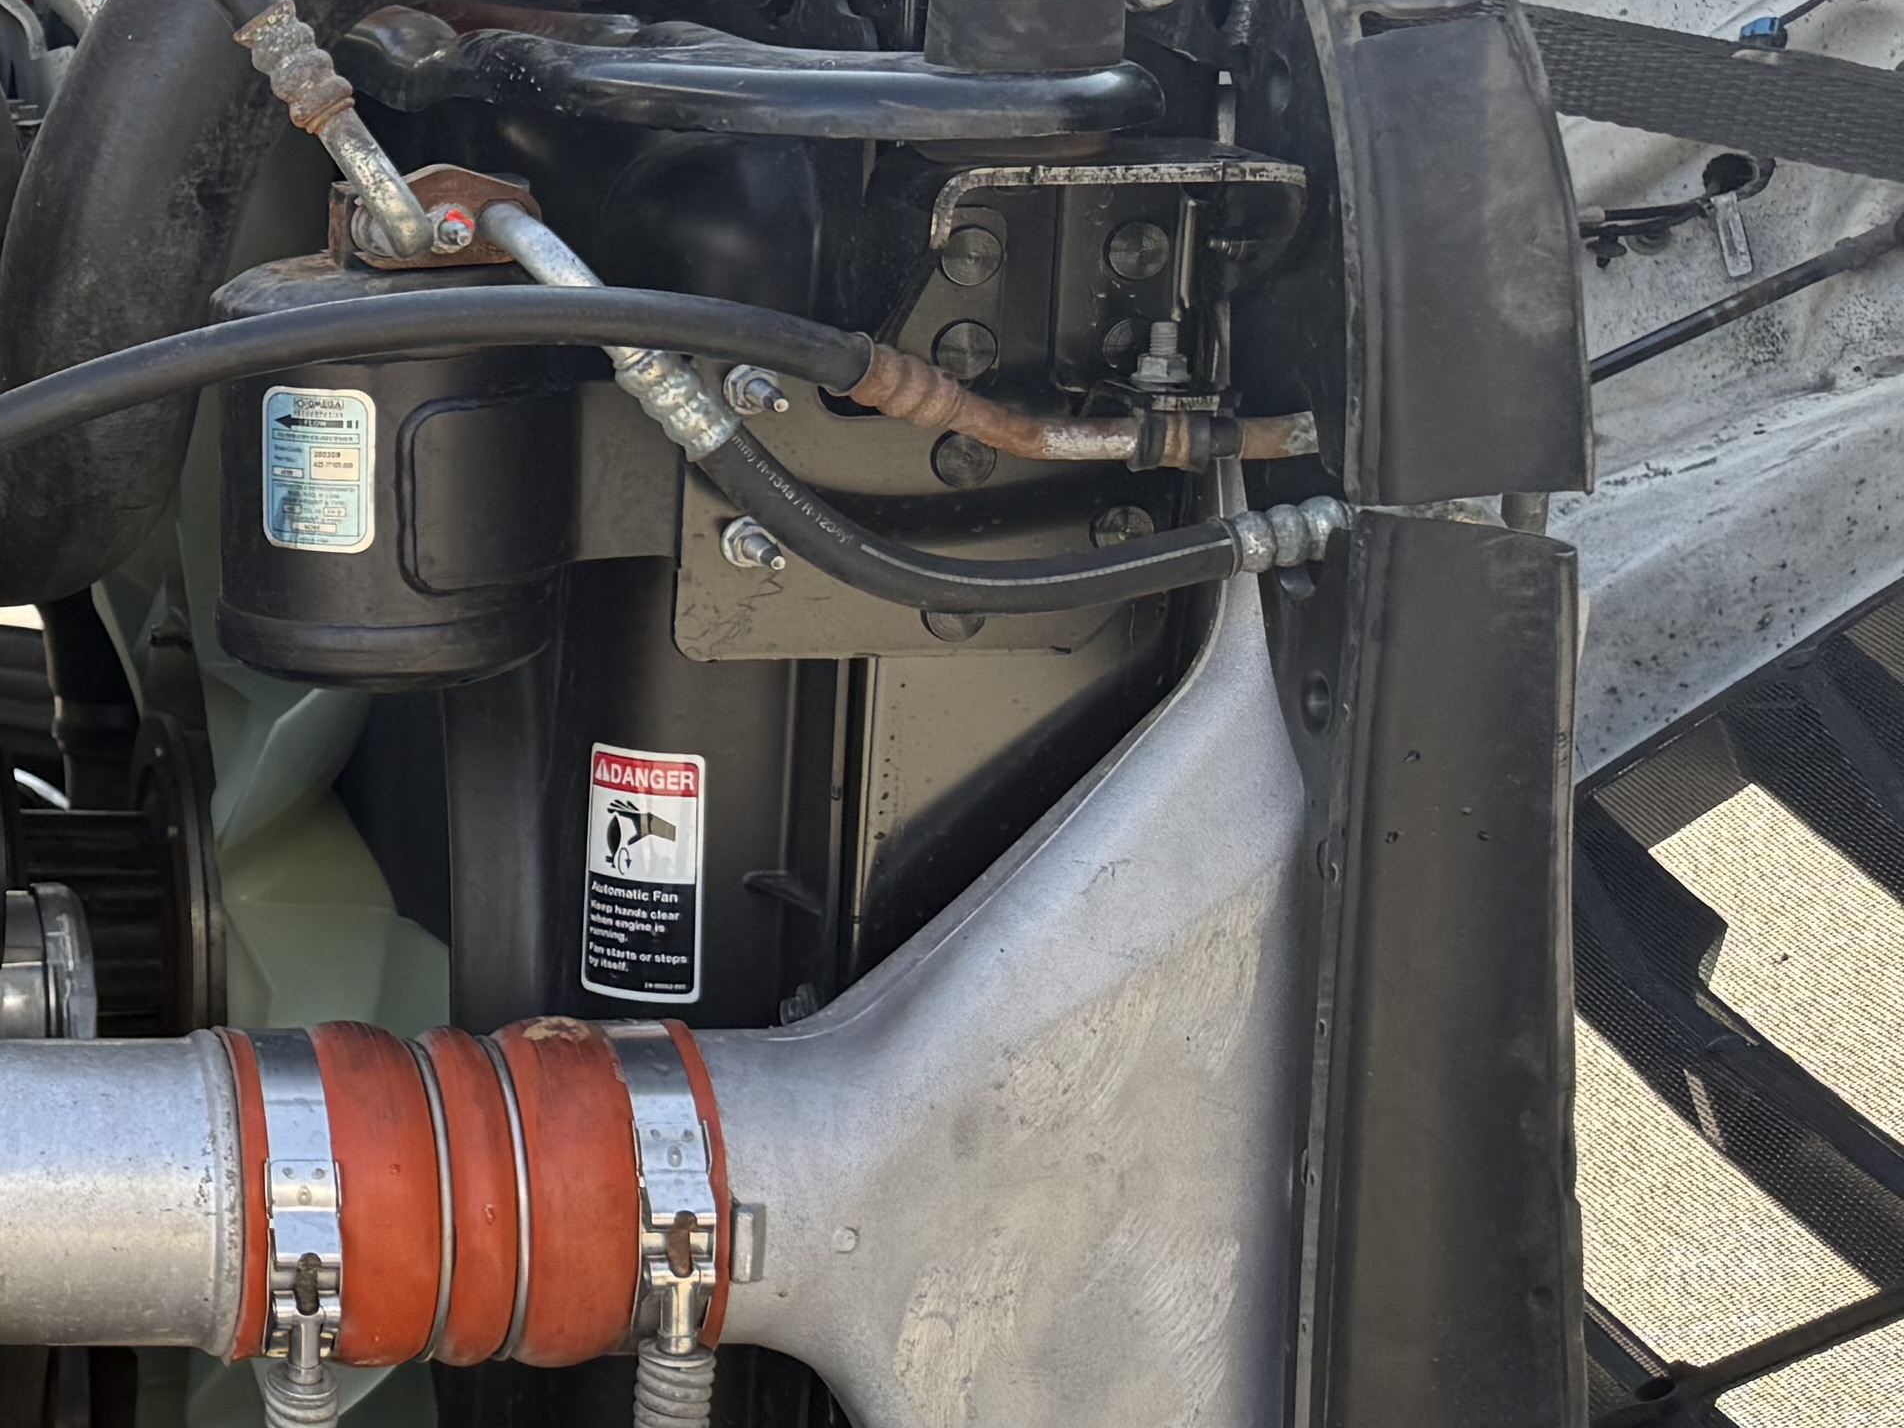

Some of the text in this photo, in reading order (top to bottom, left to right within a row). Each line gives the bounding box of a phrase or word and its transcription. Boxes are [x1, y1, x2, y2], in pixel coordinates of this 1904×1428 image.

[756, 460, 795, 500] R-134a
[610, 766, 695, 791] DANGER
[592, 880, 678, 903] Automatic Fan
[591, 899, 680, 921] Keep hands clear
[590, 913, 665, 932] when engine is
[588, 954, 629, 972] by itself.
[589, 941, 687, 965] Fan starts or stops
